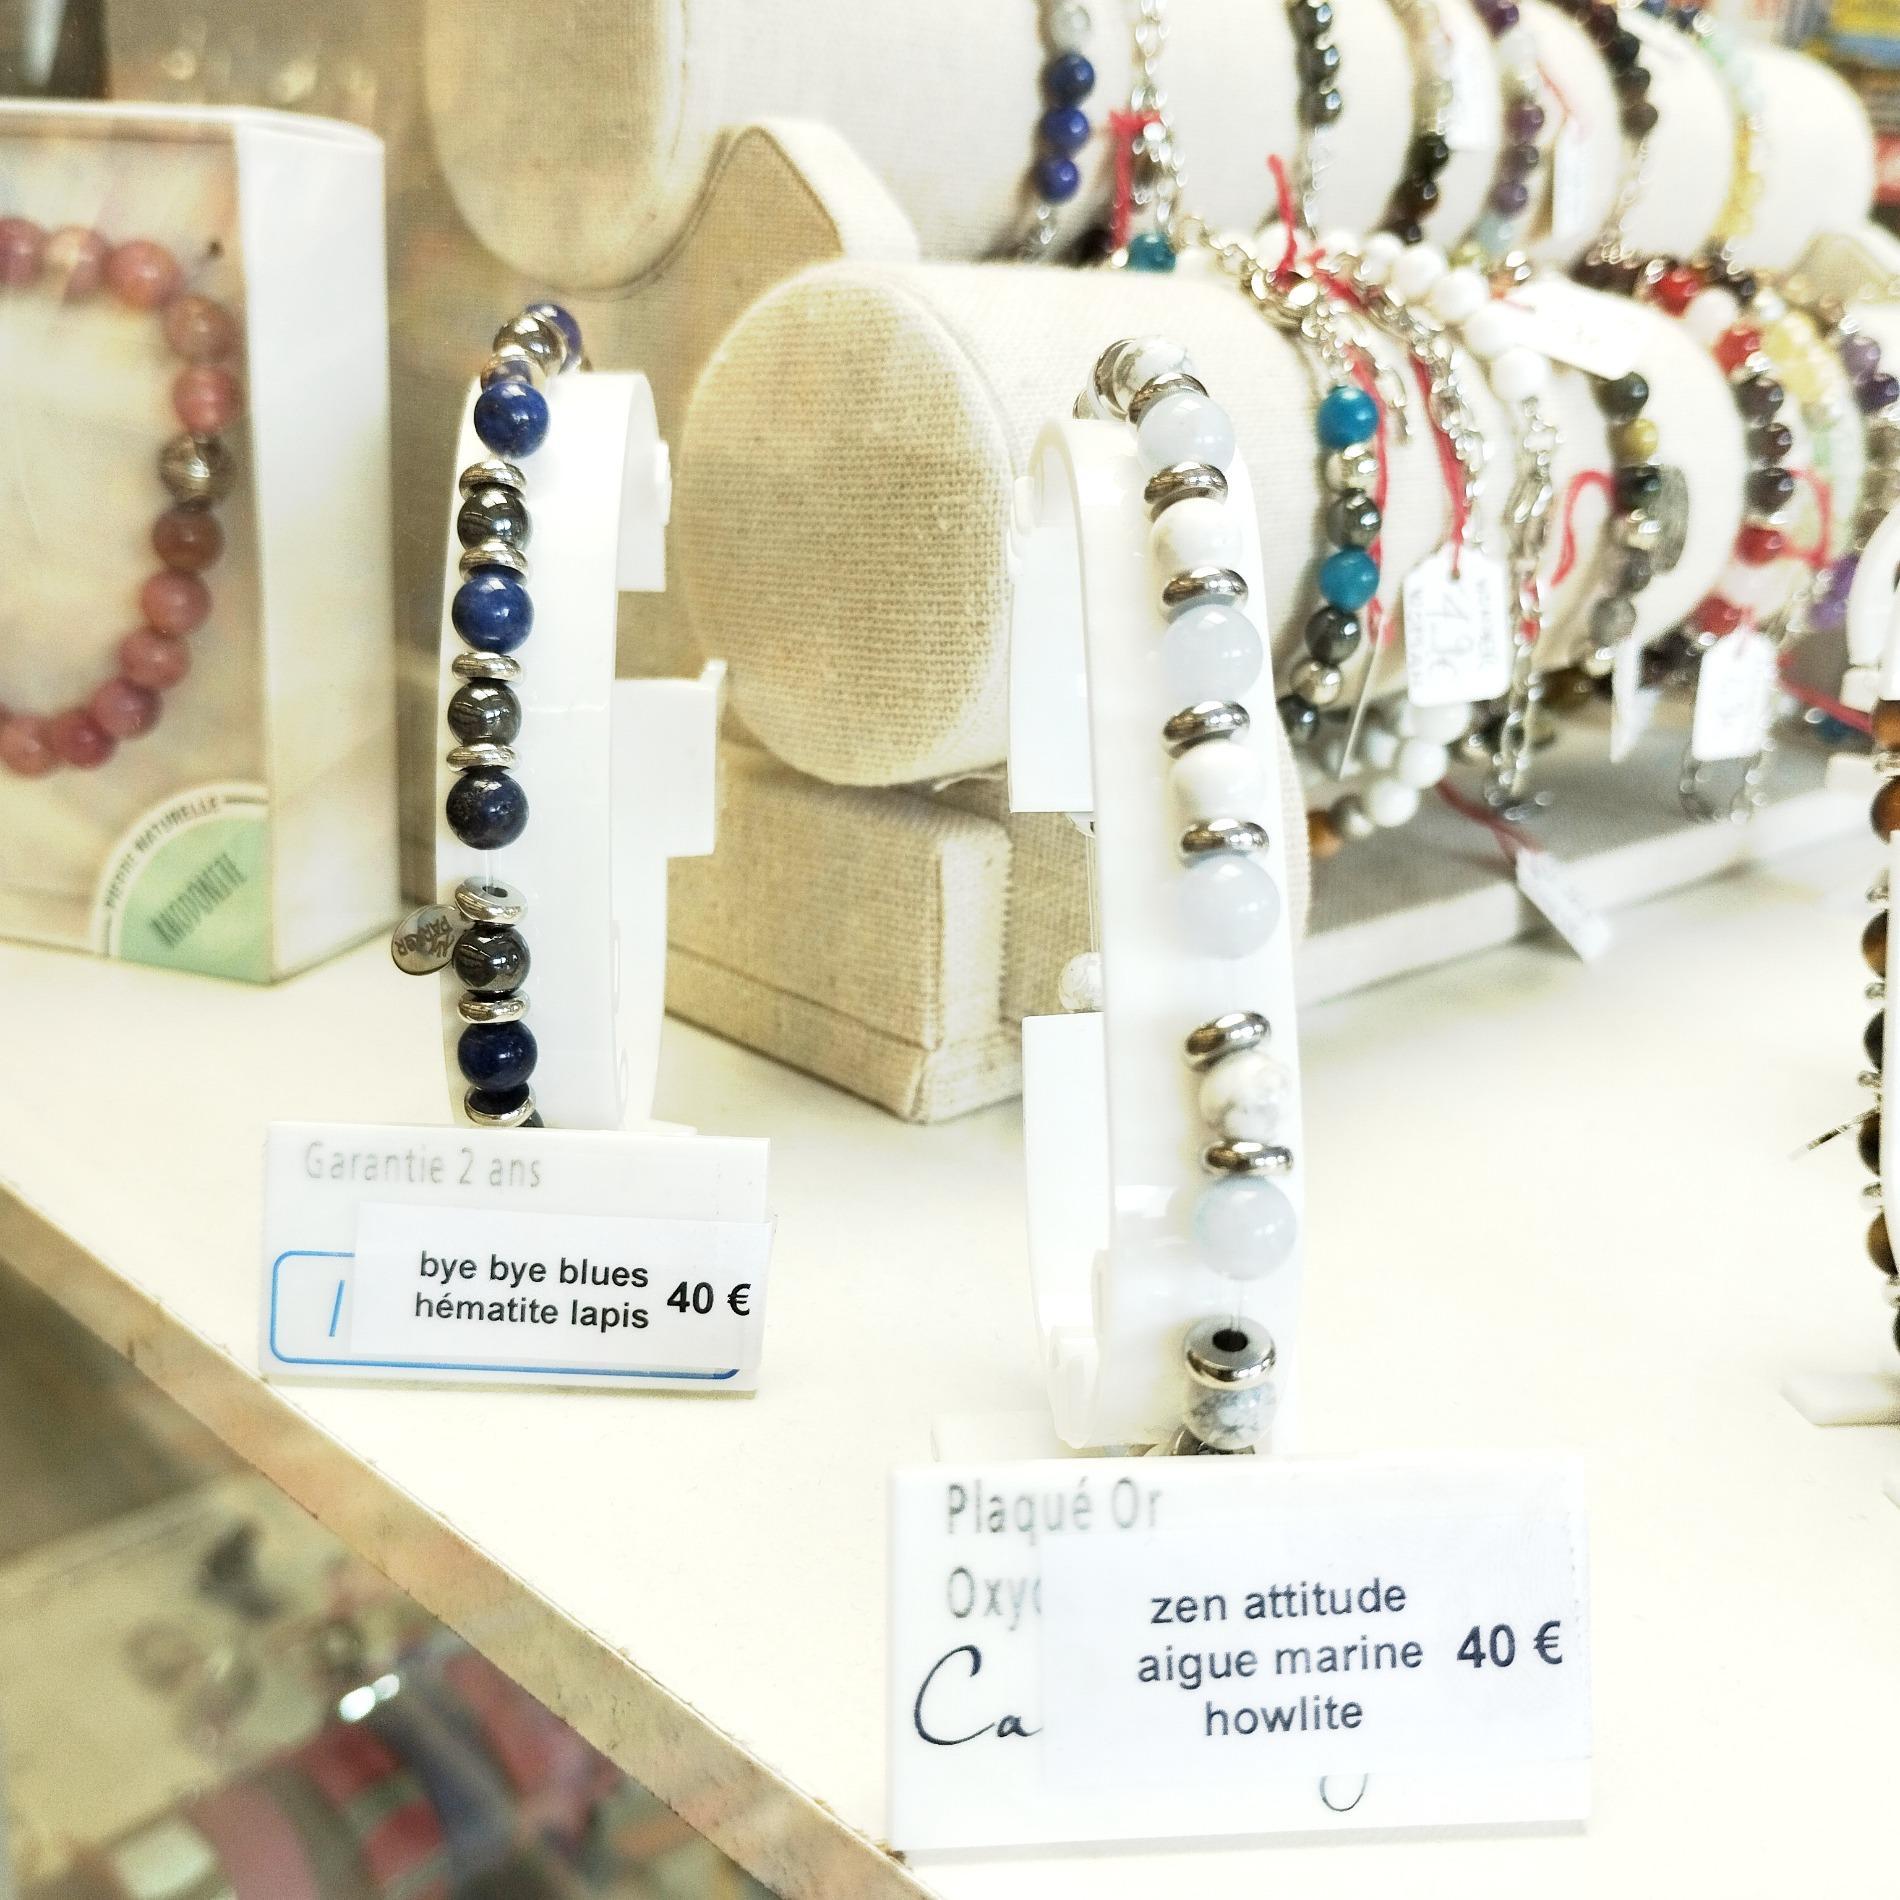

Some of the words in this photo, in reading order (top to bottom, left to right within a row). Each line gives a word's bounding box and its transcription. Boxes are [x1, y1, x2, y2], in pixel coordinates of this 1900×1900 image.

[306, 1142, 443, 1184] Garantie
[457, 1147, 473, 1185] 2
[488, 1158, 541, 1188] ans
[421, 1251, 477, 1284] bye
[490, 1254, 546, 1286] bye
[560, 1258, 648, 1287] blues
[416, 1292, 558, 1324] hématite
[572, 1300, 648, 1333] lapis
[667, 1282, 713, 1314] 40
[727, 1284, 751, 1316] €
[948, 1477, 1091, 1546] Plaqué
[1113, 1477, 1160, 1529] Or
[1151, 1595, 1227, 1624] zen
[1245, 1578, 1406, 1619] attitude
[1138, 1645, 1257, 1690] aigue
[1276, 1635, 1423, 1674] marine
[1457, 1624, 1515, 1668] 40
[1533, 1620, 1562, 1665] €
[1206, 1695, 1362, 1736] howlite
